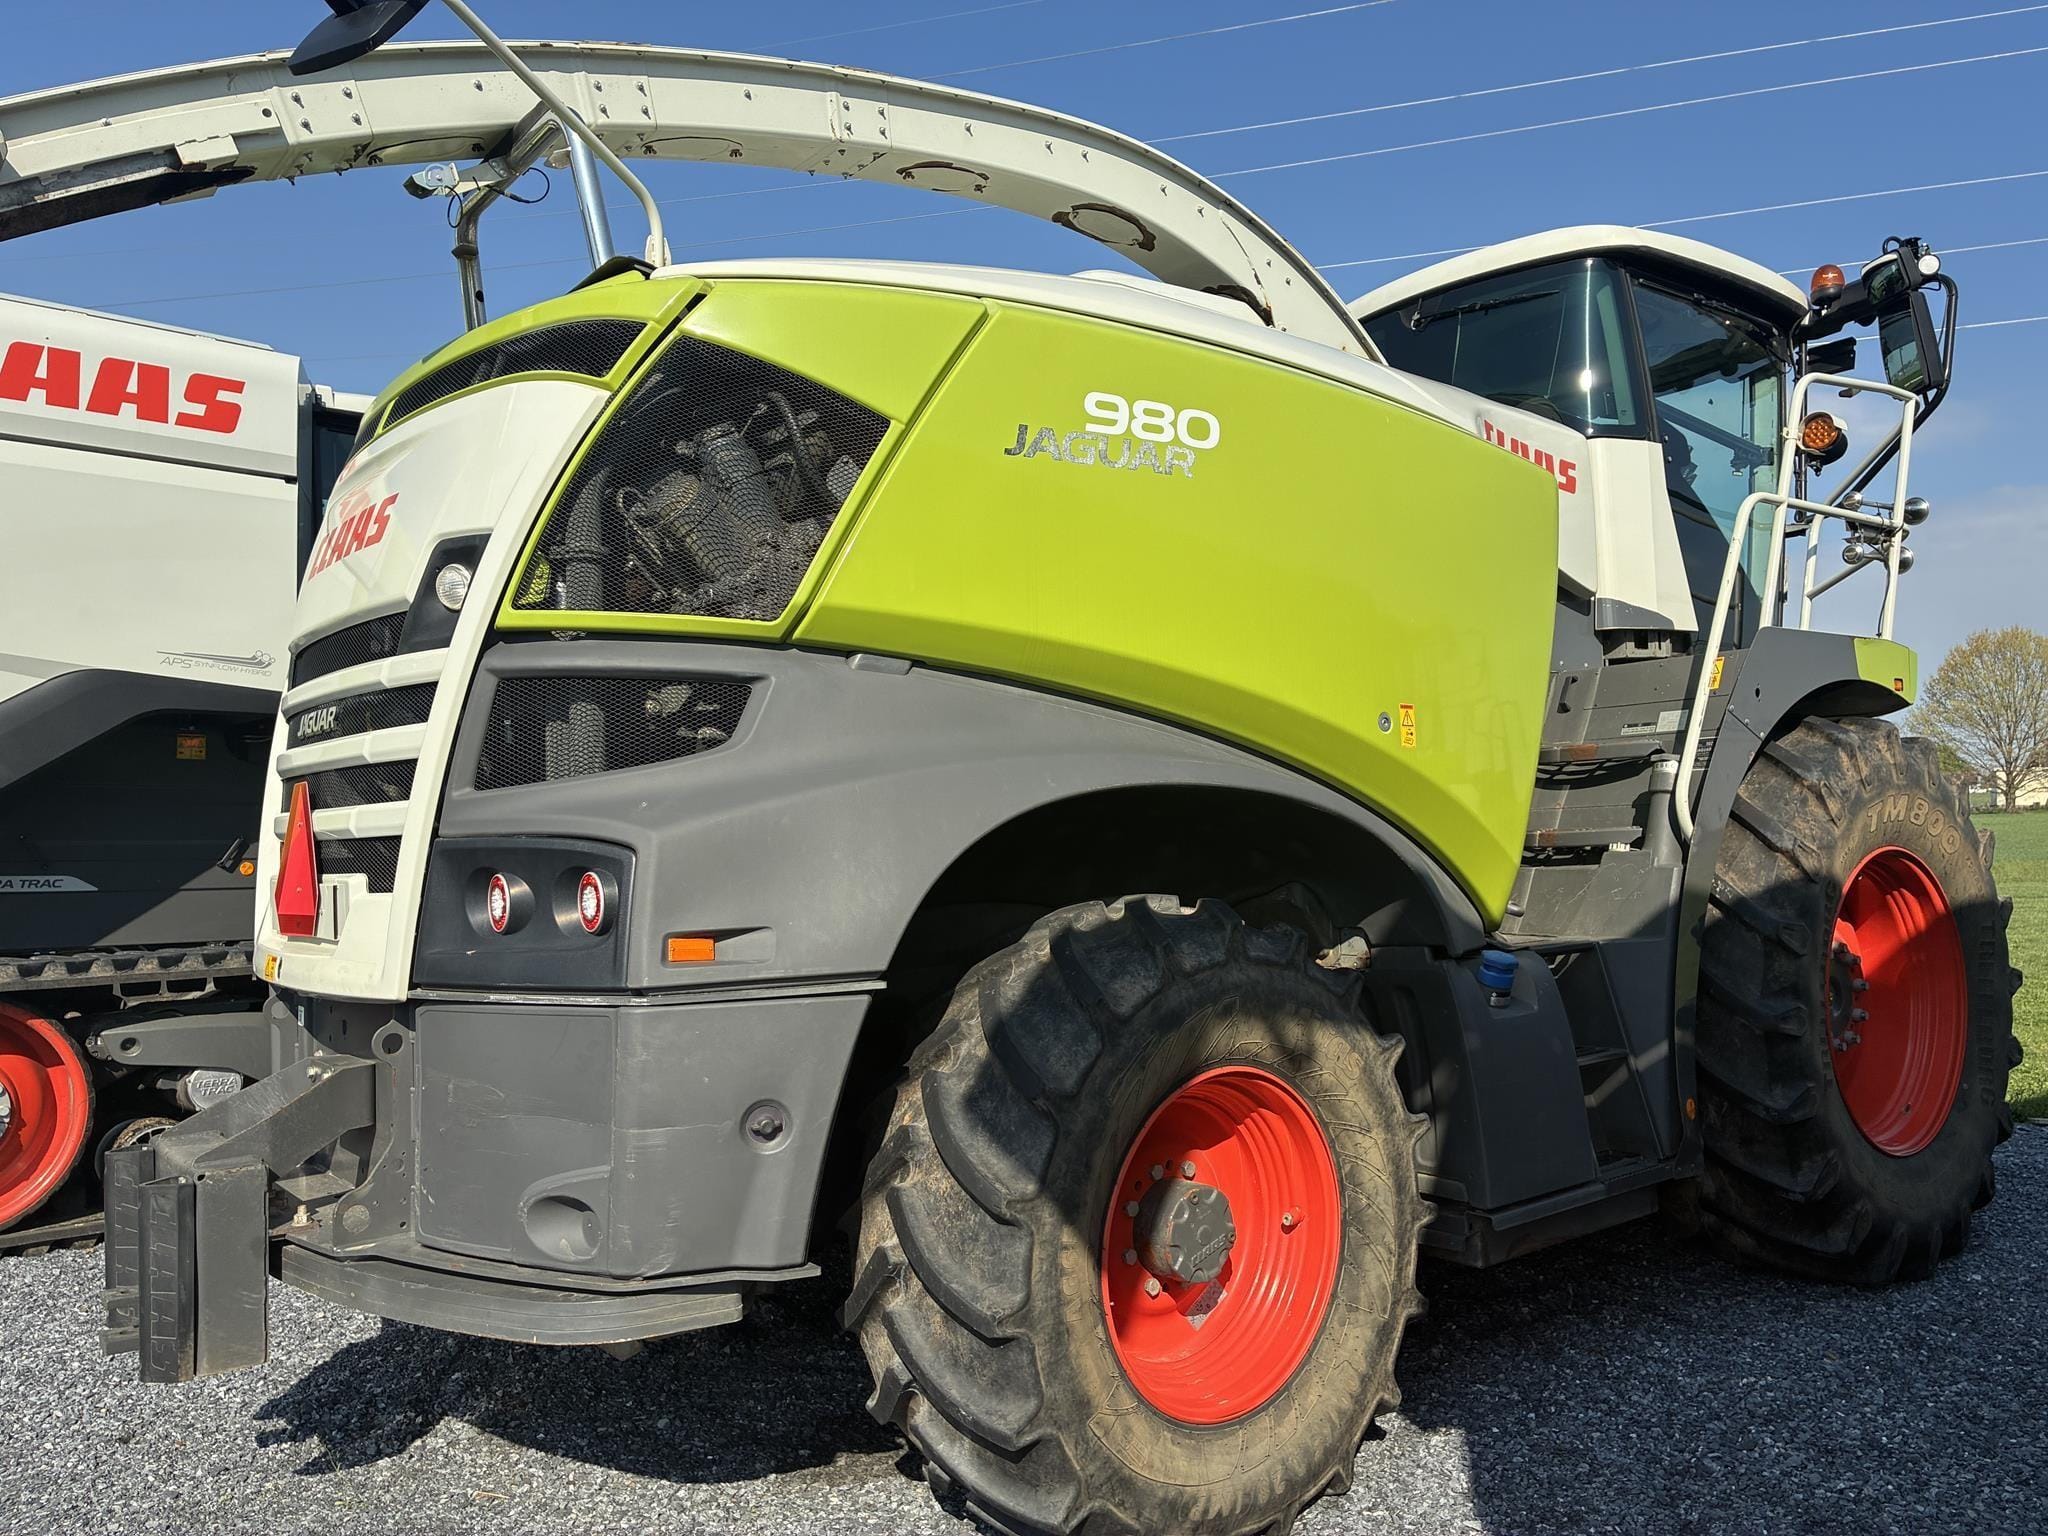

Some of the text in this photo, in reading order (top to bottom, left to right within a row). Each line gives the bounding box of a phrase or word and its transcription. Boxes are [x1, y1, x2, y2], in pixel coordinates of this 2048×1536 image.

[1083, 391, 1221, 450] 980
[1003, 423, 1197, 479] JAGUAR
[159, 656, 193, 669] APS
[1866, 792, 1962, 855] TM800
[18, 878, 64, 889] TRAC
